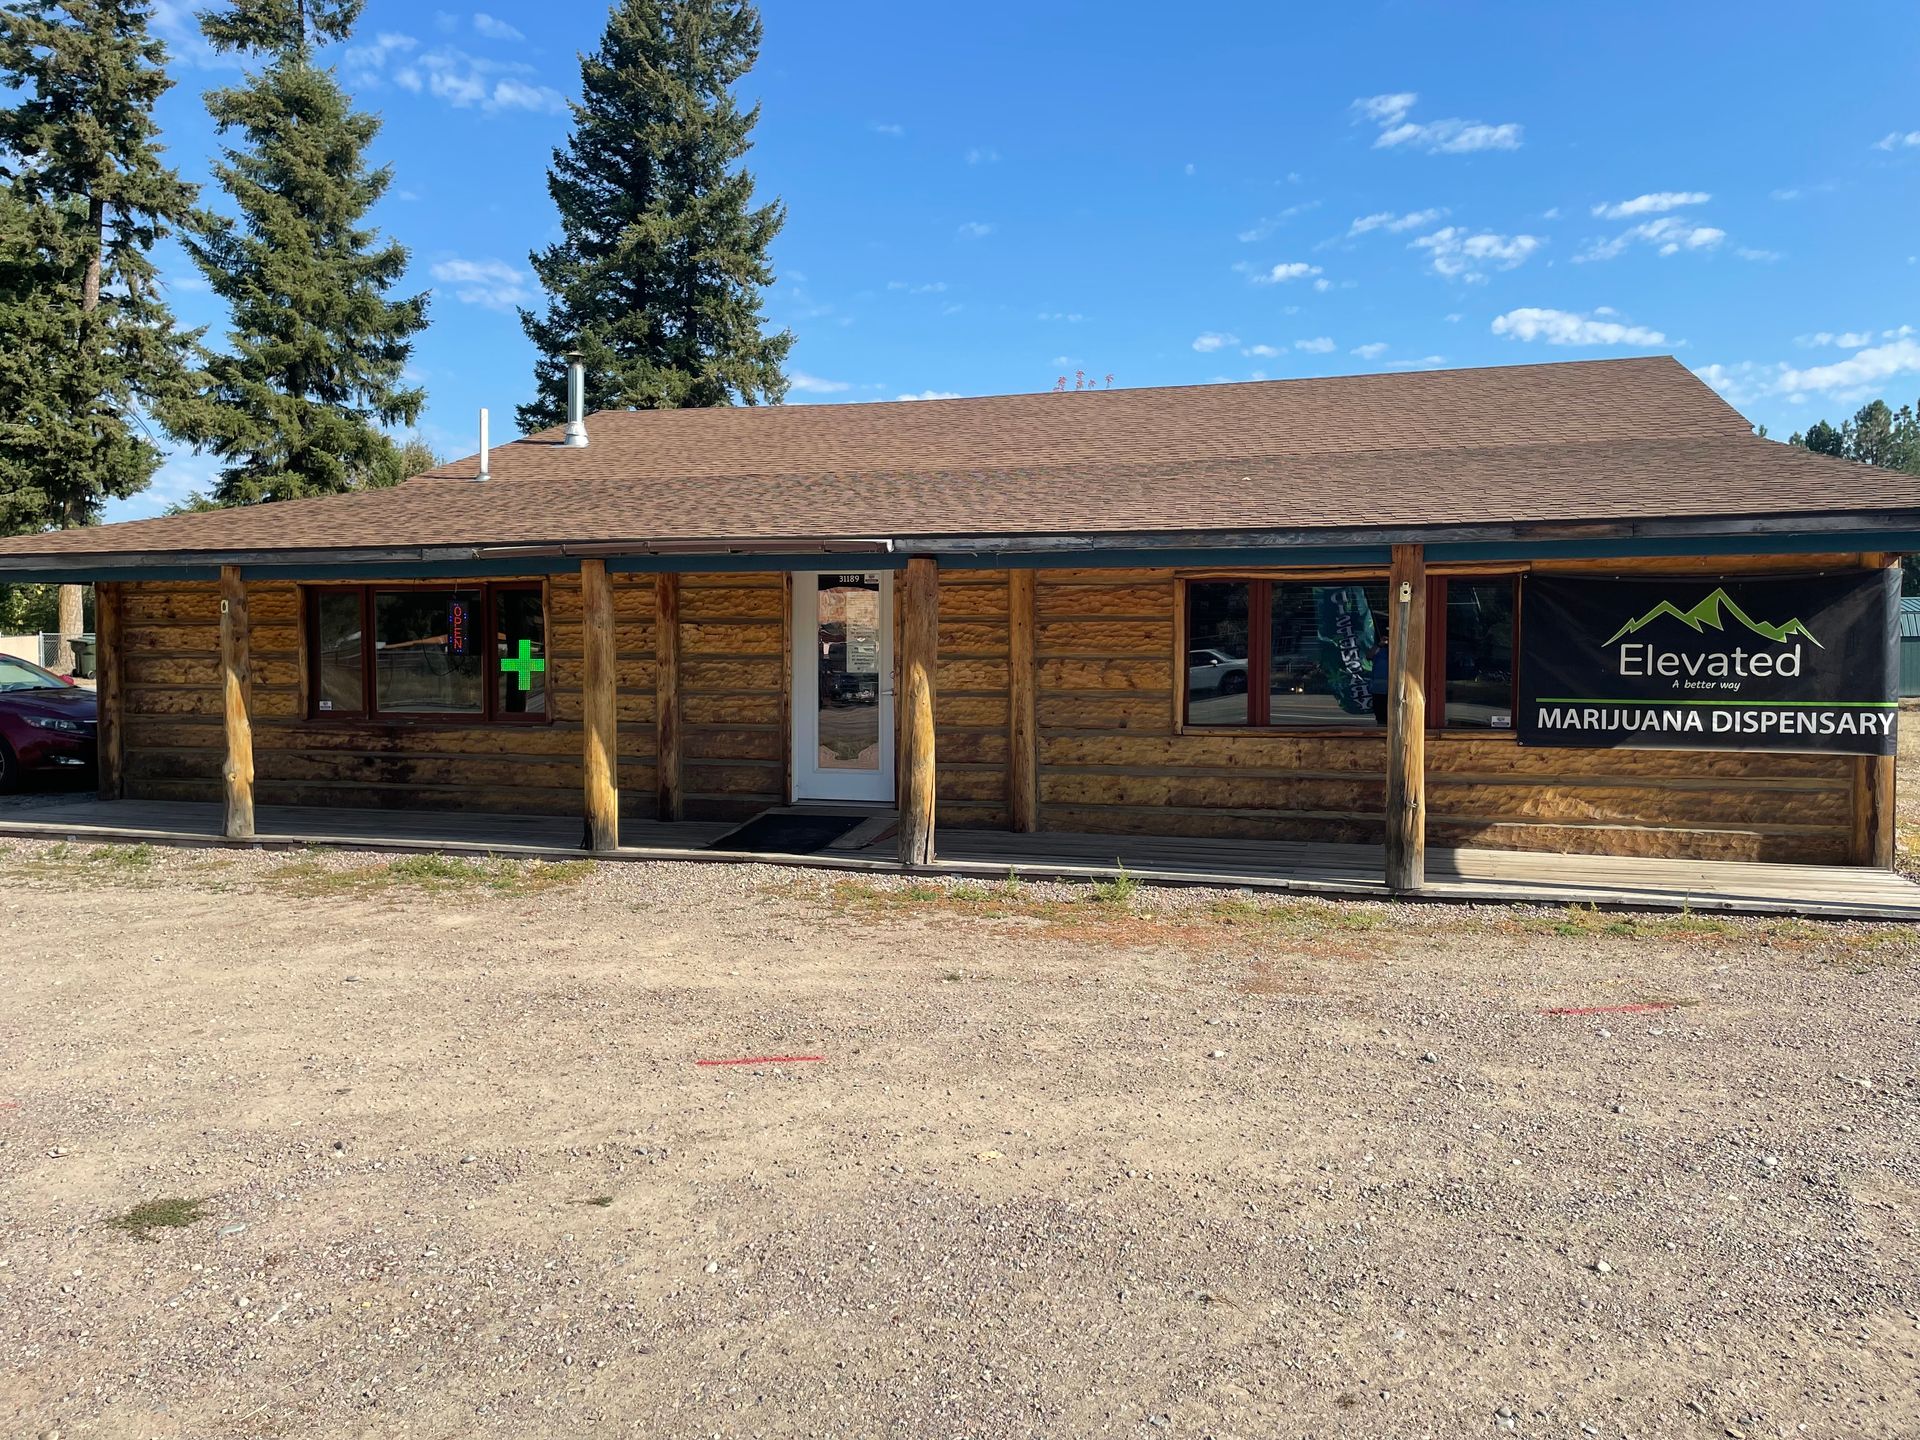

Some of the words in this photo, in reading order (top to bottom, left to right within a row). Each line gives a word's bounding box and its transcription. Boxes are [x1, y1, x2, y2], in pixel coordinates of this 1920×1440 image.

[839, 575, 860, 583] 31189
[454, 607, 462, 649] OPEN
[1619, 643, 1801, 678] Elevated
[1672, 680, 1680, 689] A
[1684, 680, 1716, 690] better
[1720, 681, 1741, 692] way
[1537, 707, 1704, 733] MARIJUANA
[1711, 711, 1895, 736] DISPENSARY
